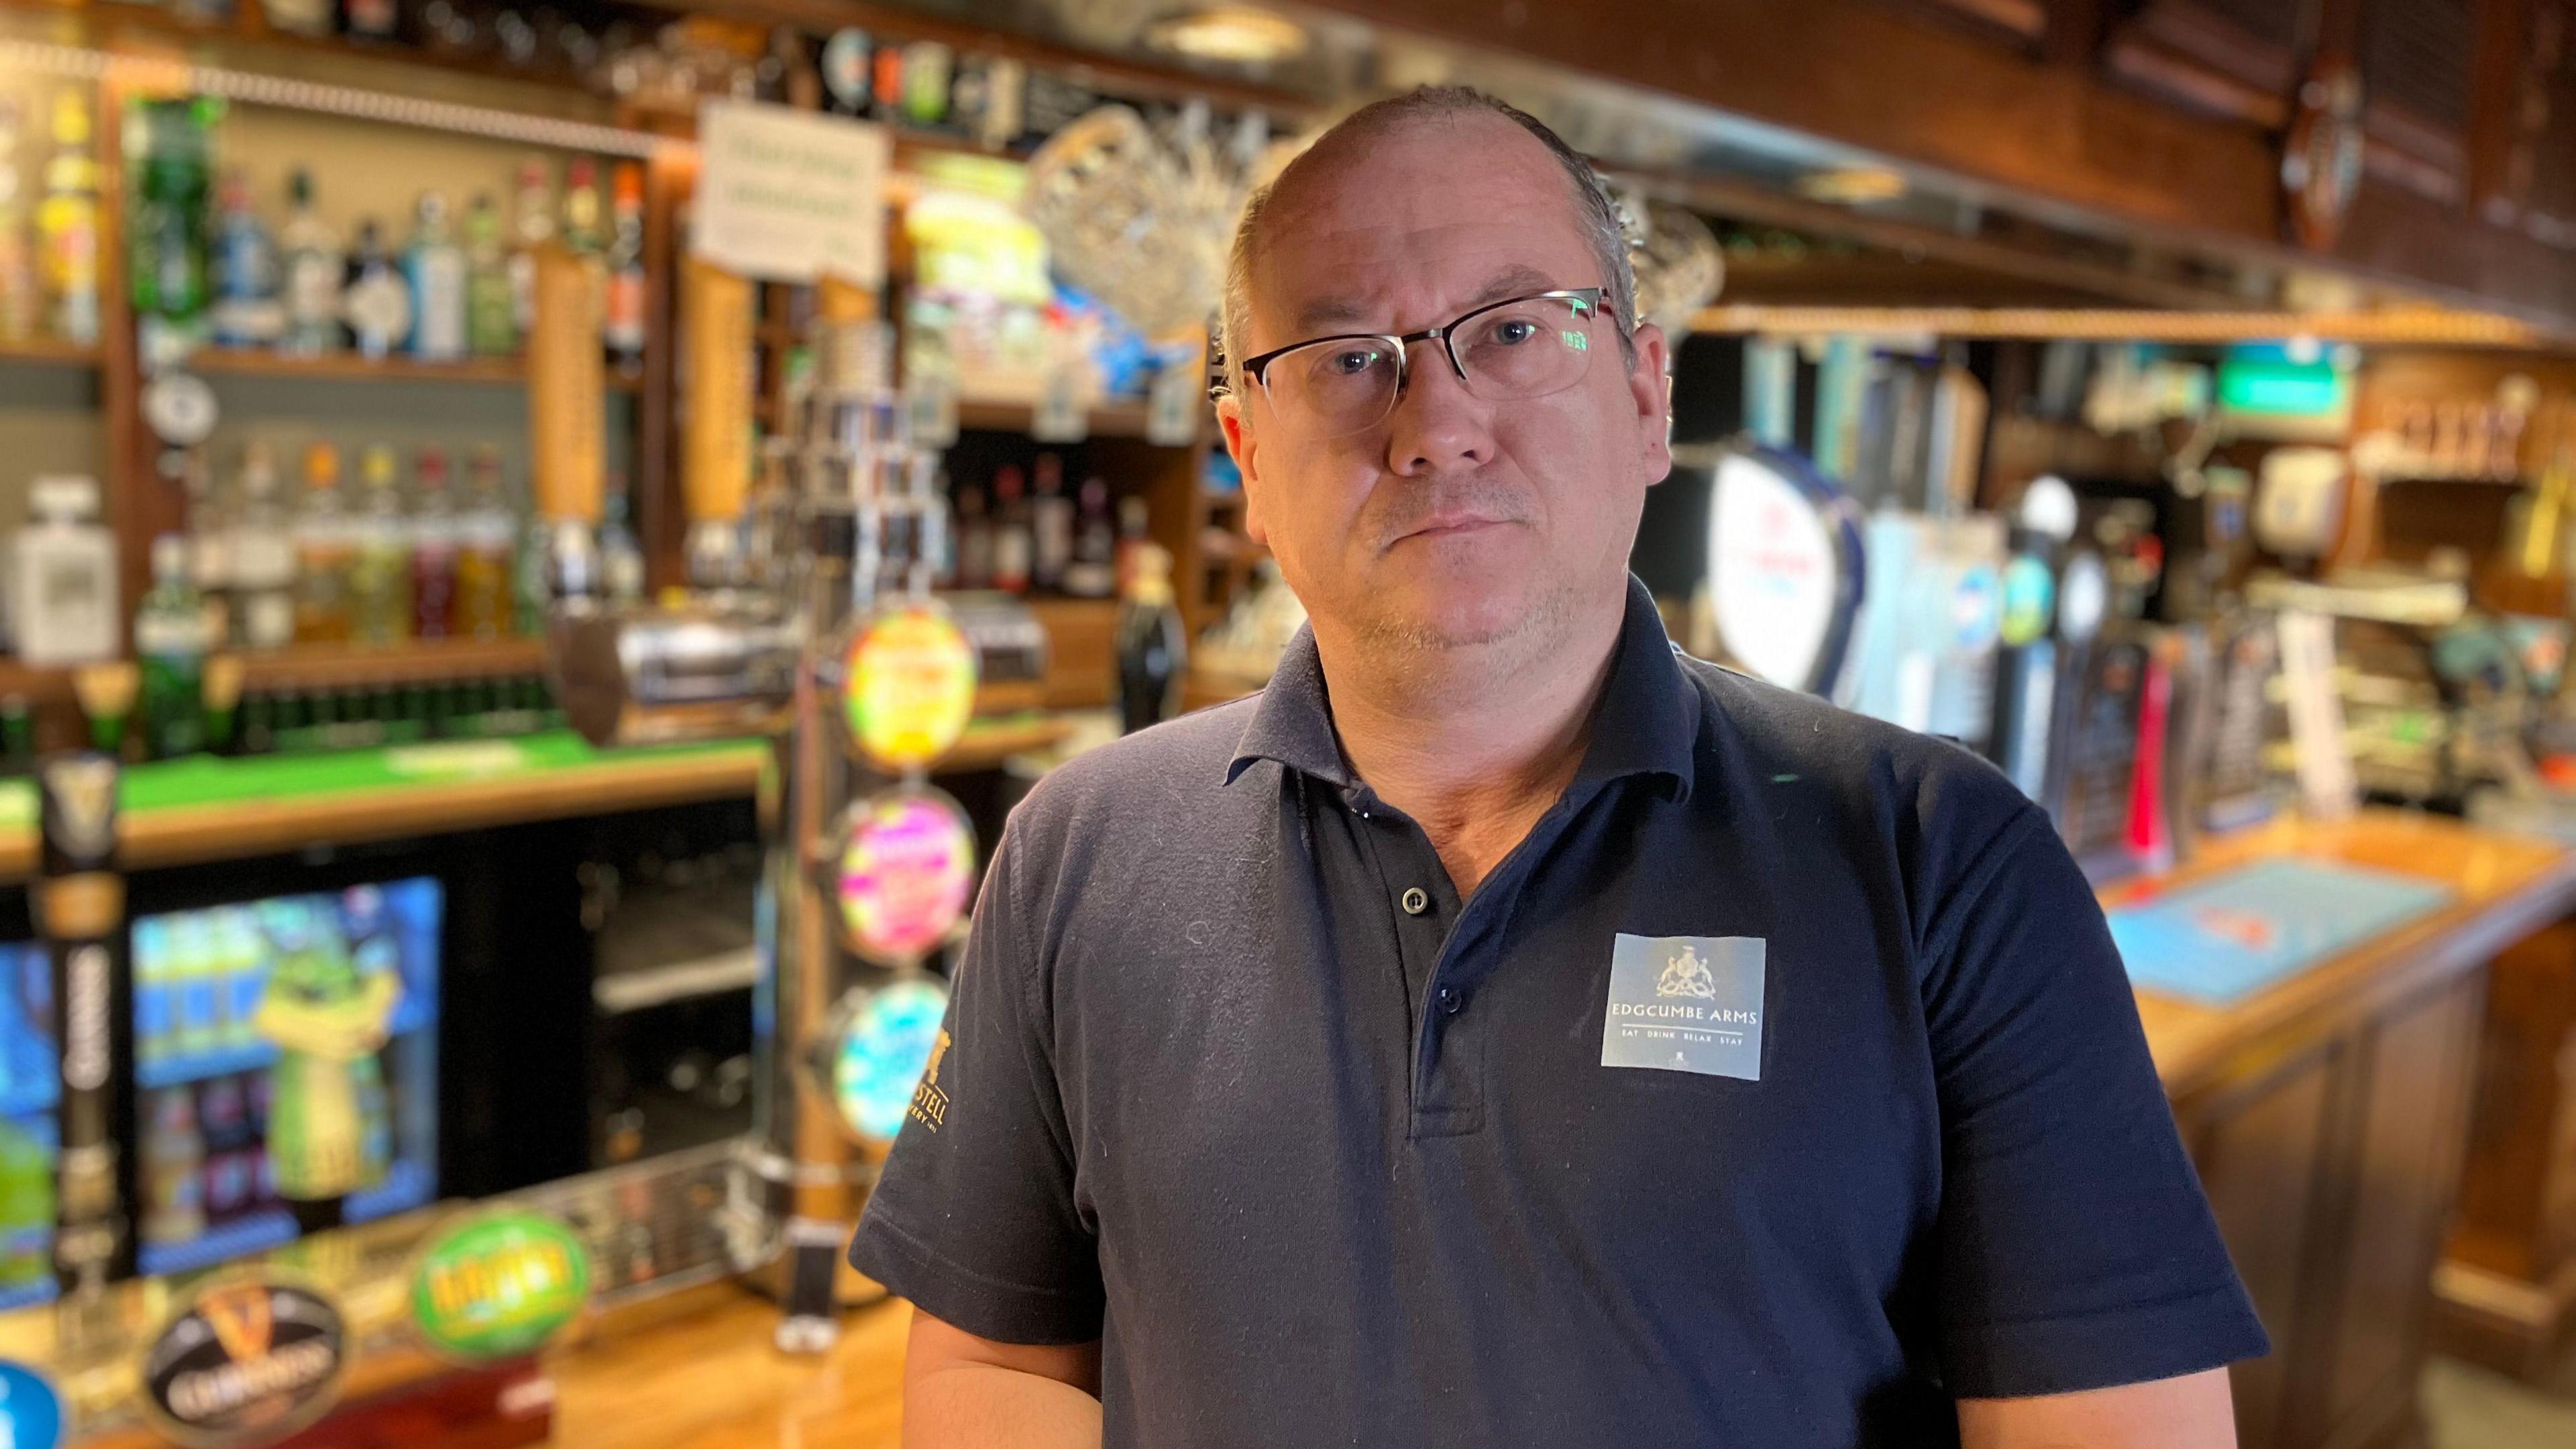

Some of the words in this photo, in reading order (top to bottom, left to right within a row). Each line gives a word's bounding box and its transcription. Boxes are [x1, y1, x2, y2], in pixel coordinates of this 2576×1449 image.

[1612, 1004, 1704, 1020] EDGCUMBE
[1710, 1009, 1758, 1025] ARMS
[1622, 1029, 1639, 1037] EAT
[1647, 1030, 1675, 1040] DRINK
[1684, 1032, 1712, 1042] RELAX
[1720, 1037, 1743, 1046] STAY
[915, 1083, 946, 1126] STELL
